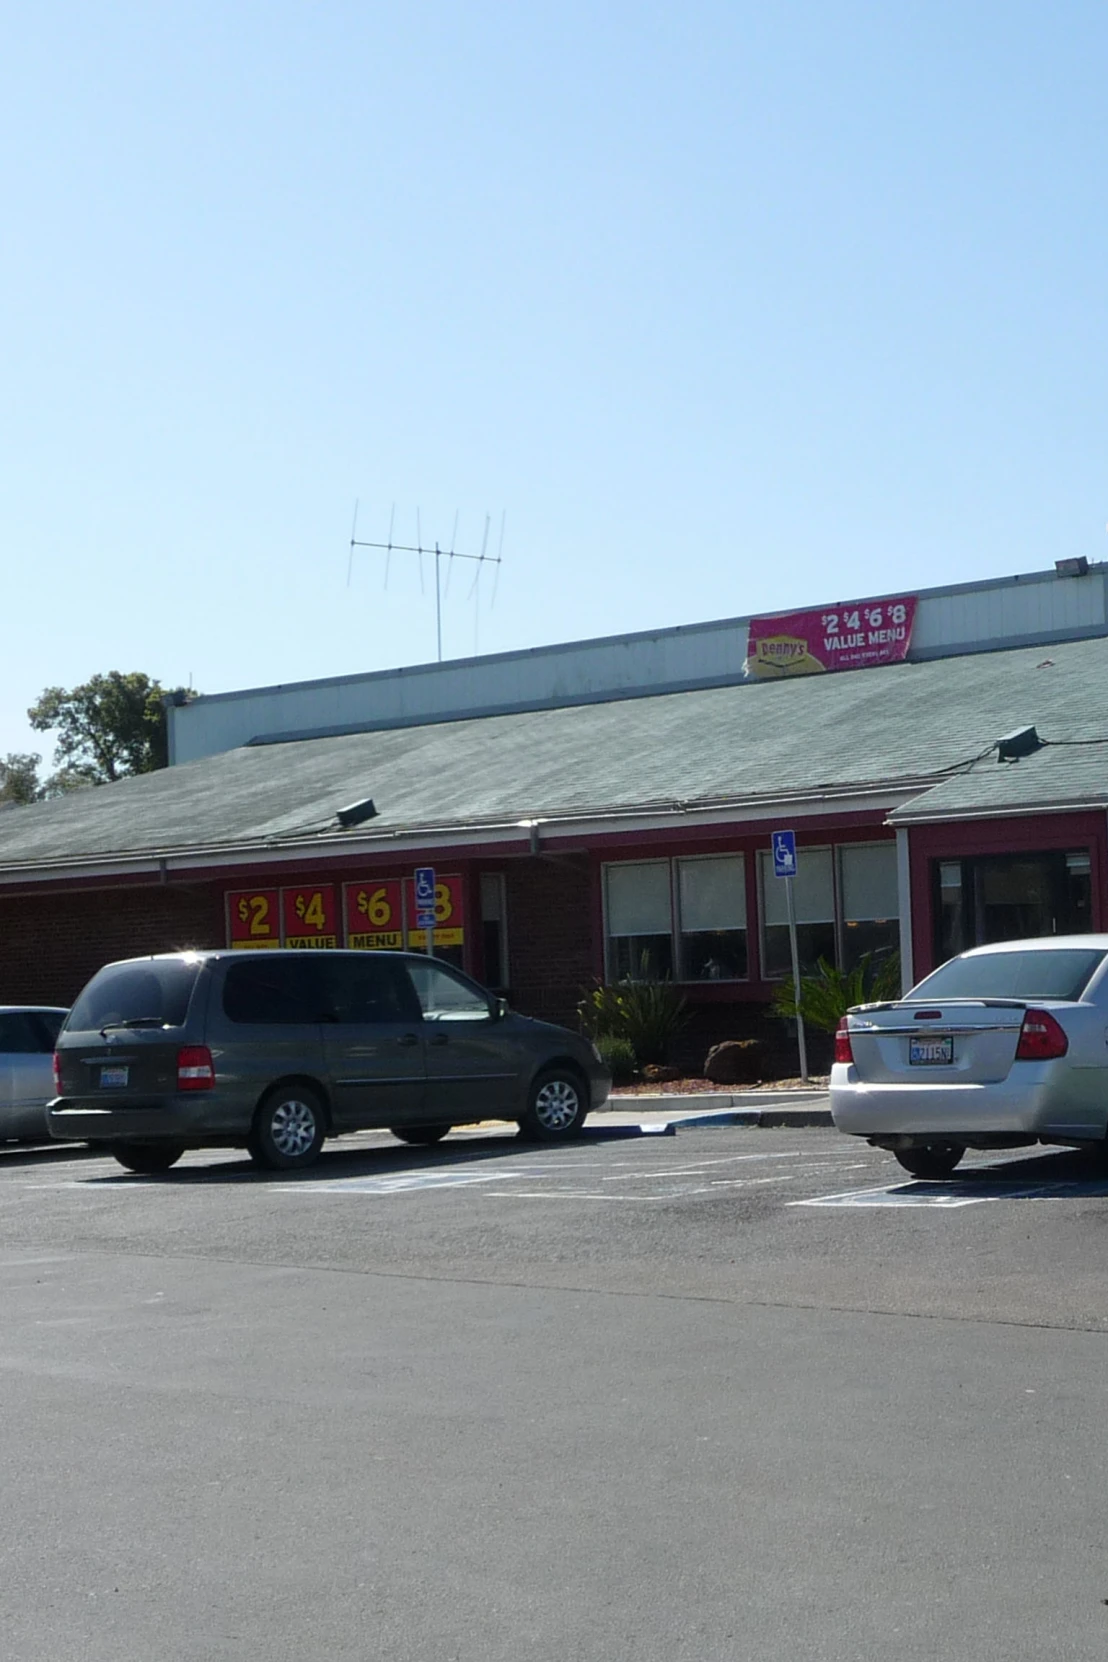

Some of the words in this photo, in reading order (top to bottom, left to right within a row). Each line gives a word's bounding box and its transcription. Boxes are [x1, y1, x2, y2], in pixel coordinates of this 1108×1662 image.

[822, 614, 839, 634] $2
[843, 611, 860, 630] $4
[864, 607, 882, 627] $6
[887, 604, 906, 624] $8
[761, 641, 805, 657] Denny's
[823, 633, 865, 651] VALUE
[868, 627, 905, 645] MENU
[238, 896, 271, 935] $2
[296, 892, 326, 931] $4
[356, 888, 391, 926] $6
[289, 936, 333, 949] VALUE
[353, 934, 397, 948] MENU
